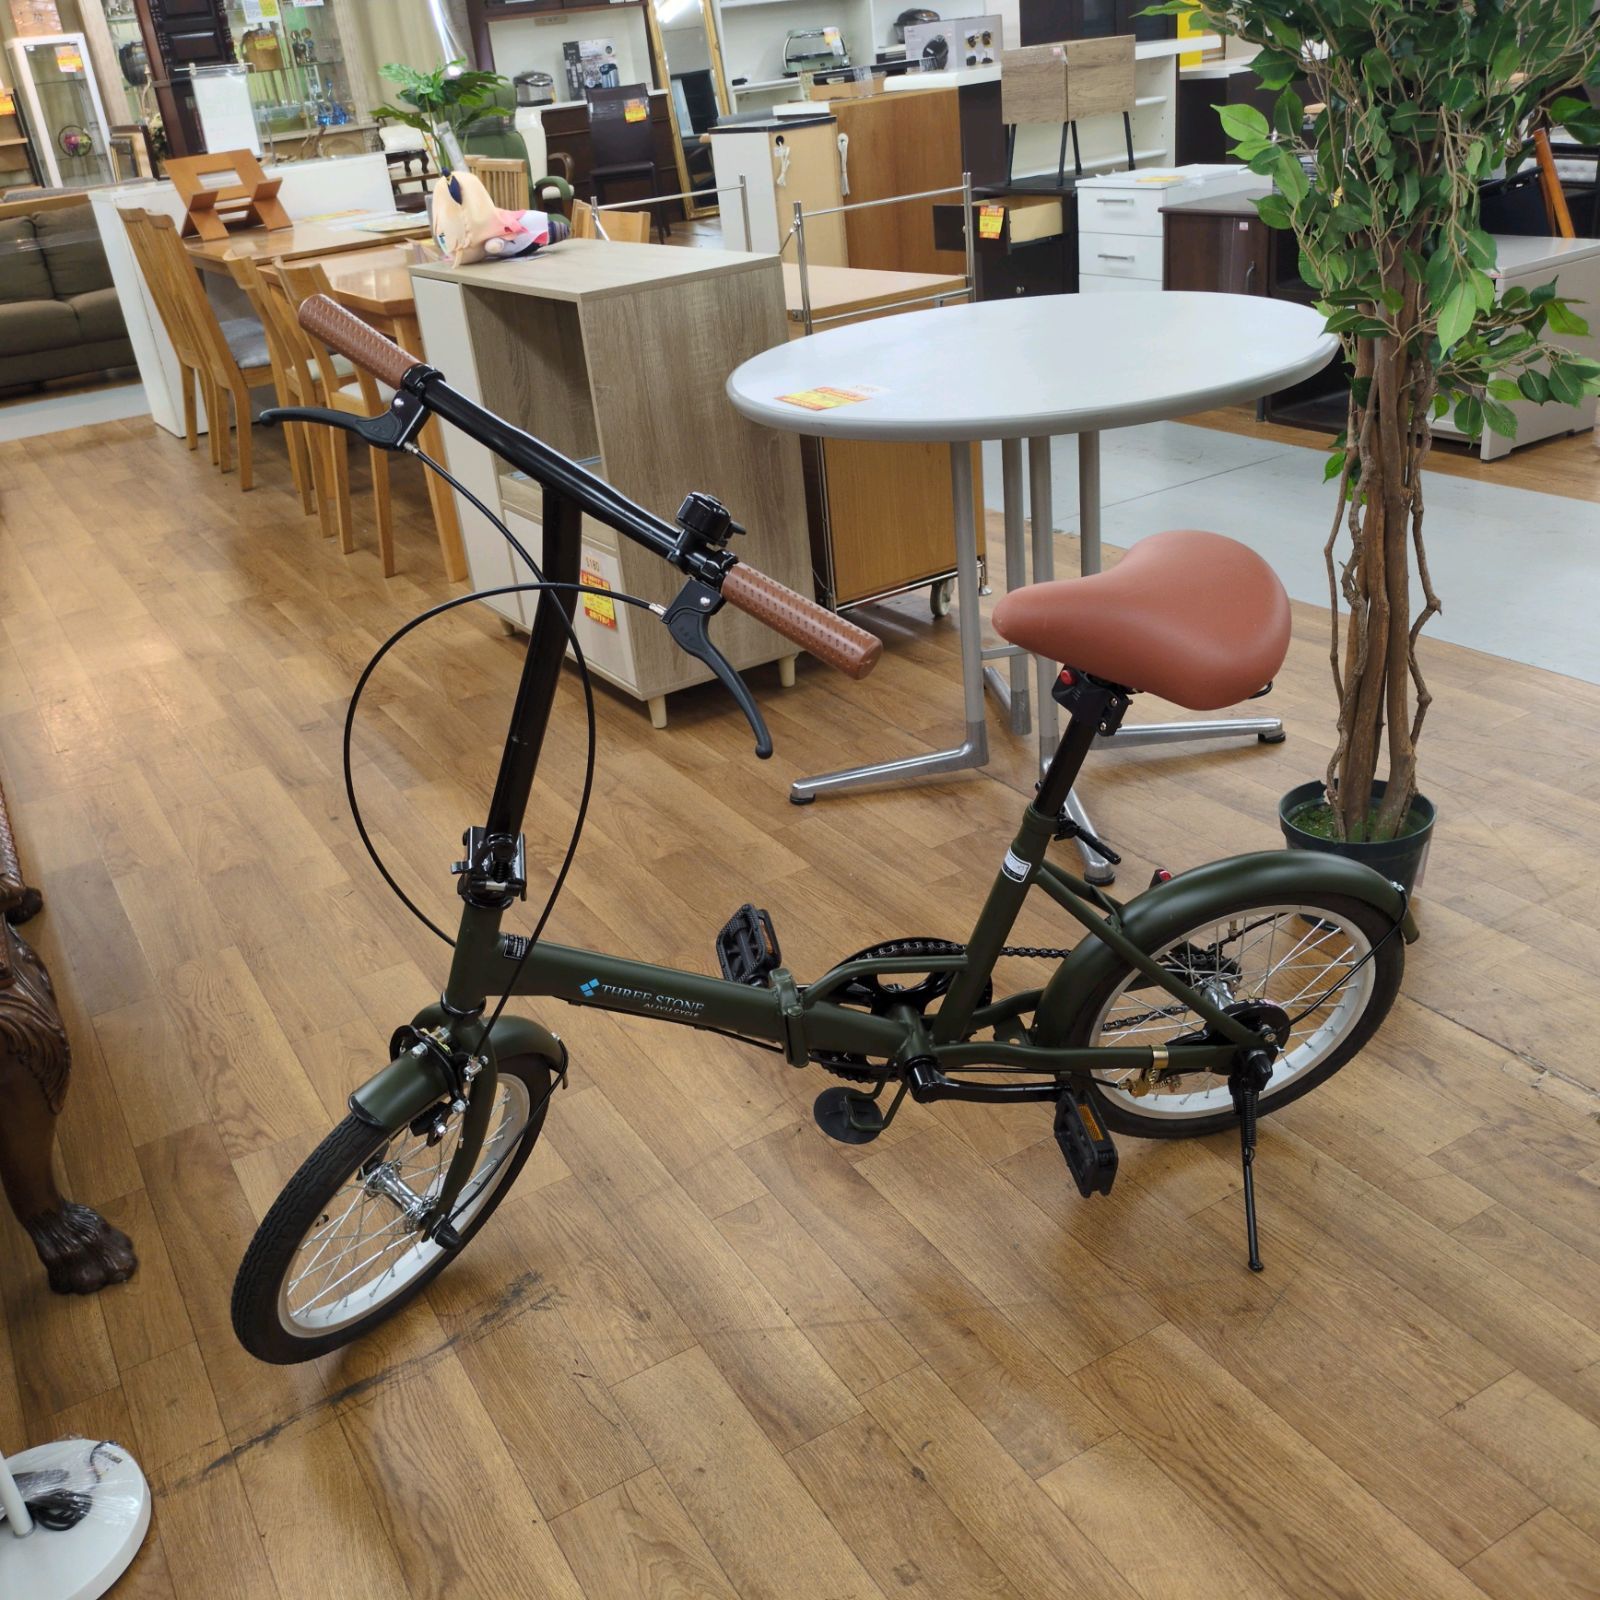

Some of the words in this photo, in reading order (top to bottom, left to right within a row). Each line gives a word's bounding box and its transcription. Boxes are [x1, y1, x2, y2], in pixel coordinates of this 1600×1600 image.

[602, 984, 652, 1000] THREE
[655, 994, 705, 1011] STONE
[673, 1008, 700, 1017] CYCLE
